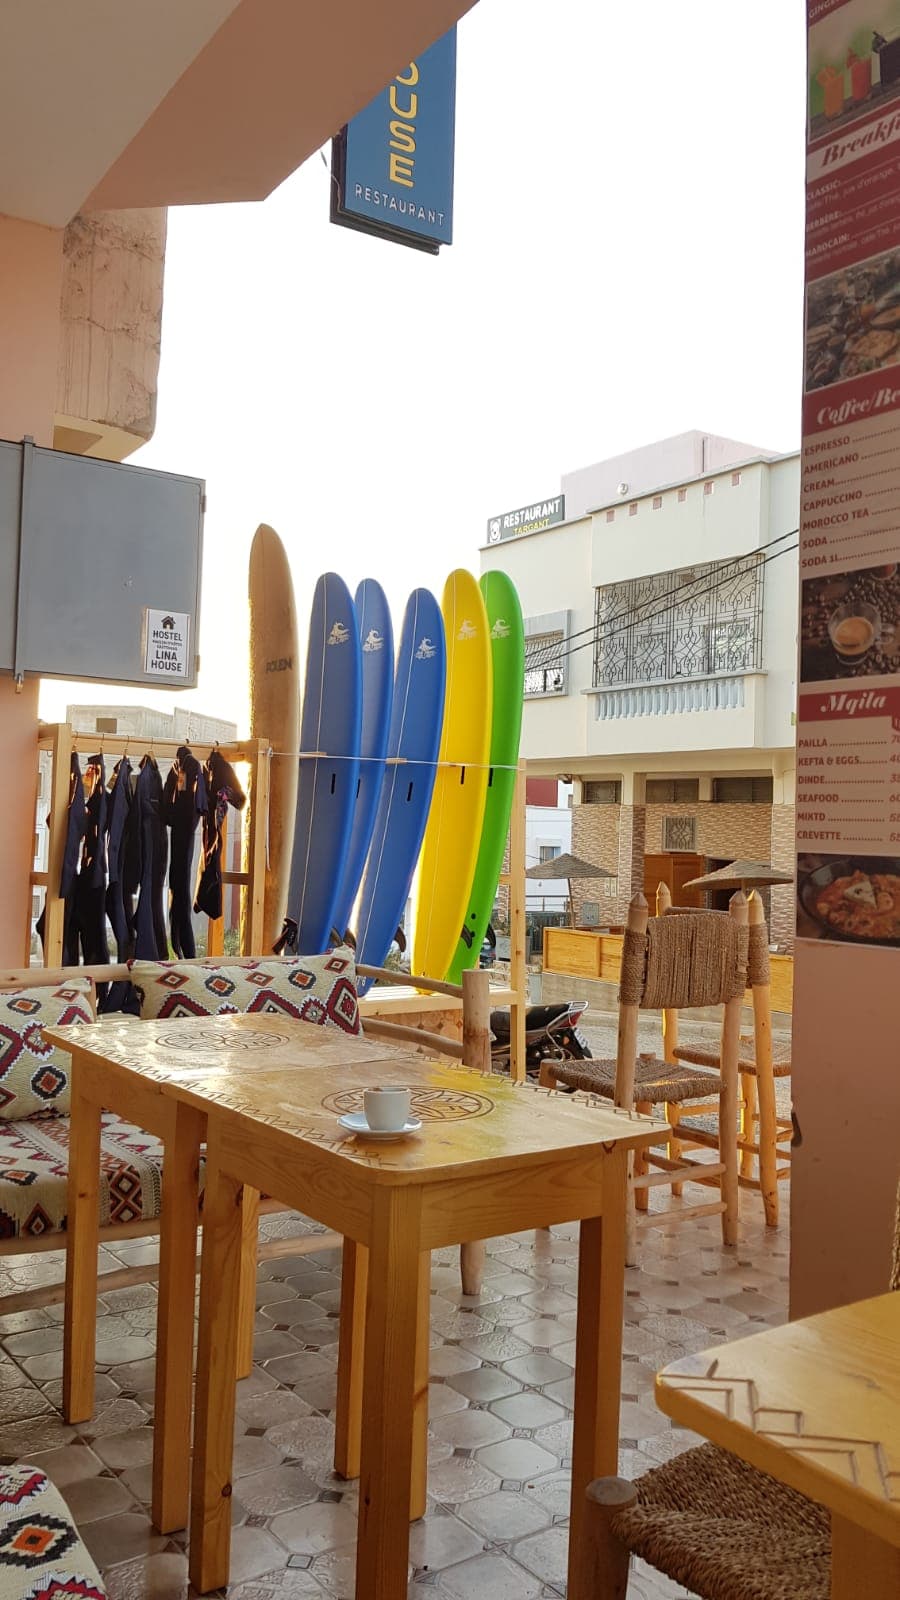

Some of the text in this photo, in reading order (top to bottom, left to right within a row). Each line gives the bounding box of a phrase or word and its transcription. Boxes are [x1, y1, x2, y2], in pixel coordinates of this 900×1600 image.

[355, 183, 444, 226] RESTAURANT
[804, 435, 850, 456] ESPRESSO
[803, 452, 859, 475] AMERICANO
[803, 477, 835, 493] CREAM
[803, 490, 863, 512] CAPPUCCINO
[503, 499, 560, 528] RESTAURANT
[802, 508, 869, 531] MOROCCO TEA
[513, 518, 549, 534] TARGANT
[802, 536, 828, 550] SODA
[801, 555, 827, 568] SODA
[153, 630, 182, 641] HOSTEL
[156, 649, 177, 661] LINA
[151, 660, 182, 672] HOUSE
[820, 691, 887, 715] Mqila
[798, 738, 828, 748] PAILLA
[798, 757, 824, 766] KEFTA
[826, 756, 834, 765] &
[835, 755, 860, 765] EGGS
[798, 775, 825, 784] DINDE
[797, 793, 839, 803] SEAFOOD
[796, 830, 841, 840] CREVETTE
